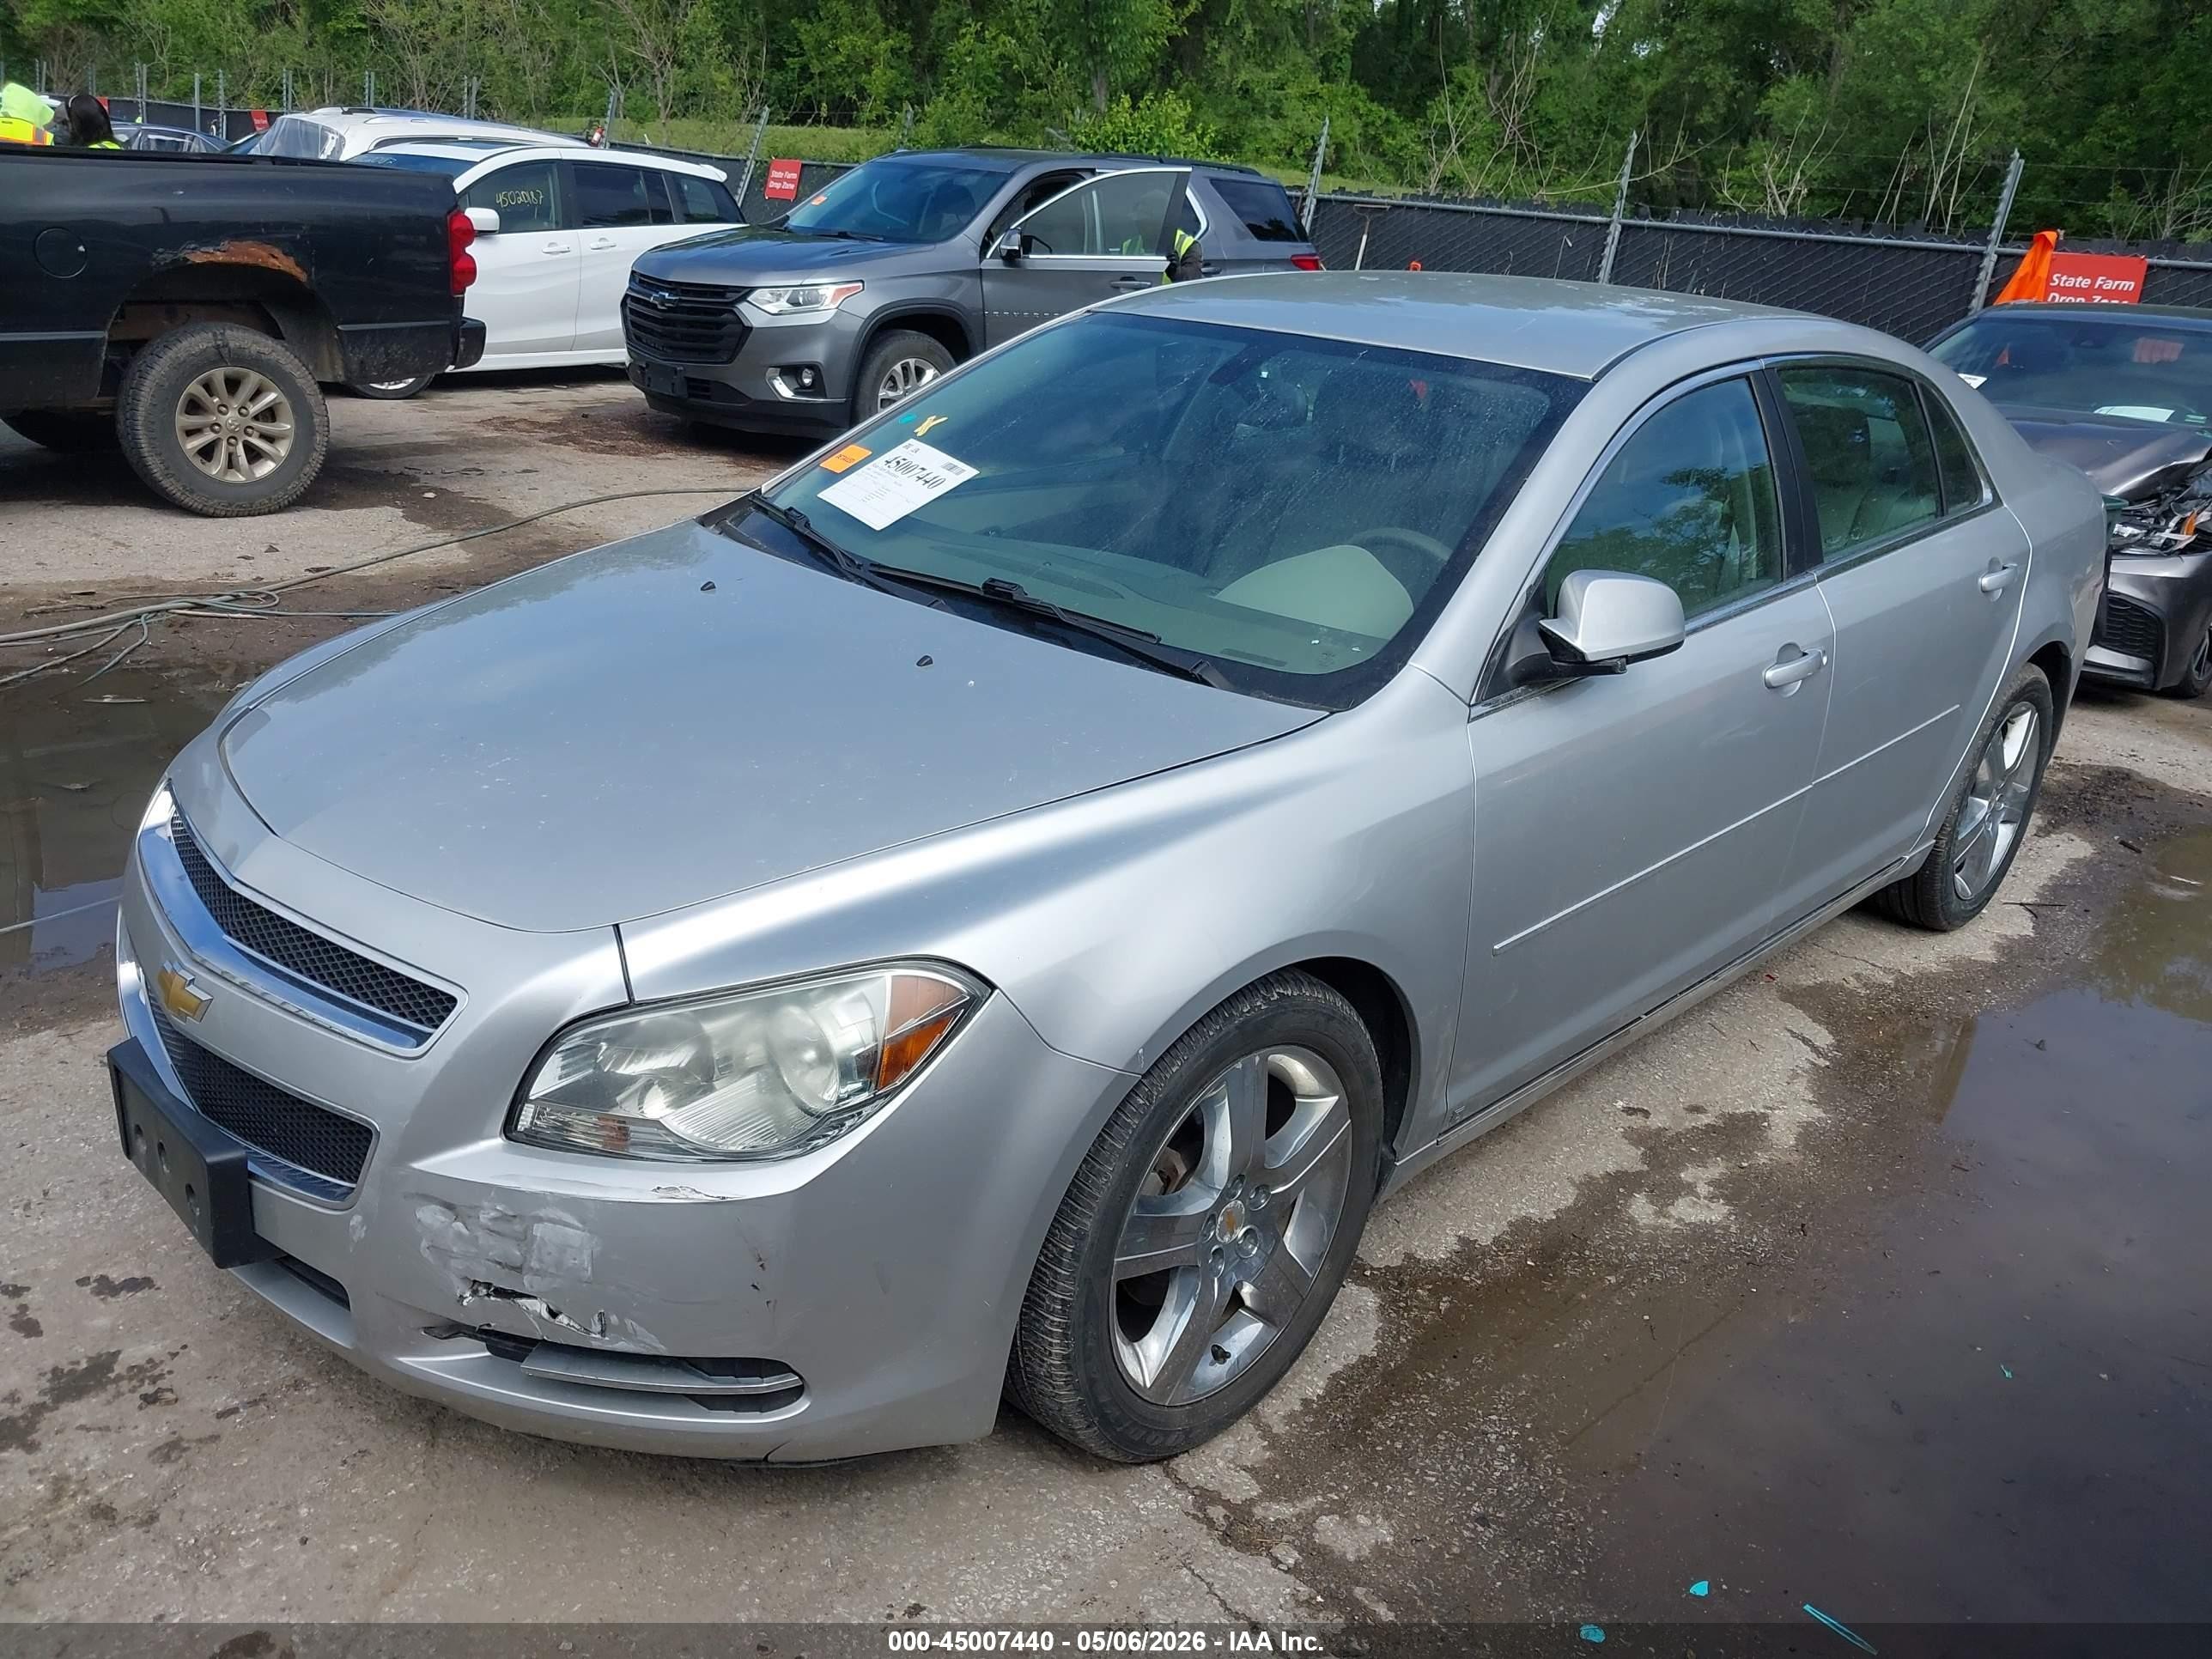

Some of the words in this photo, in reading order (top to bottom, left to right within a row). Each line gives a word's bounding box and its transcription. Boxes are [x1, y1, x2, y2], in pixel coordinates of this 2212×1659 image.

[770, 170, 784, 179] State
[784, 171, 798, 179] Farm
[769, 180, 781, 190] Drop
[781, 181, 795, 190] Zone
[2050, 273, 2091, 289] State
[2094, 276, 2136, 291] Farm
[884, 455, 947, 489] 45007440
